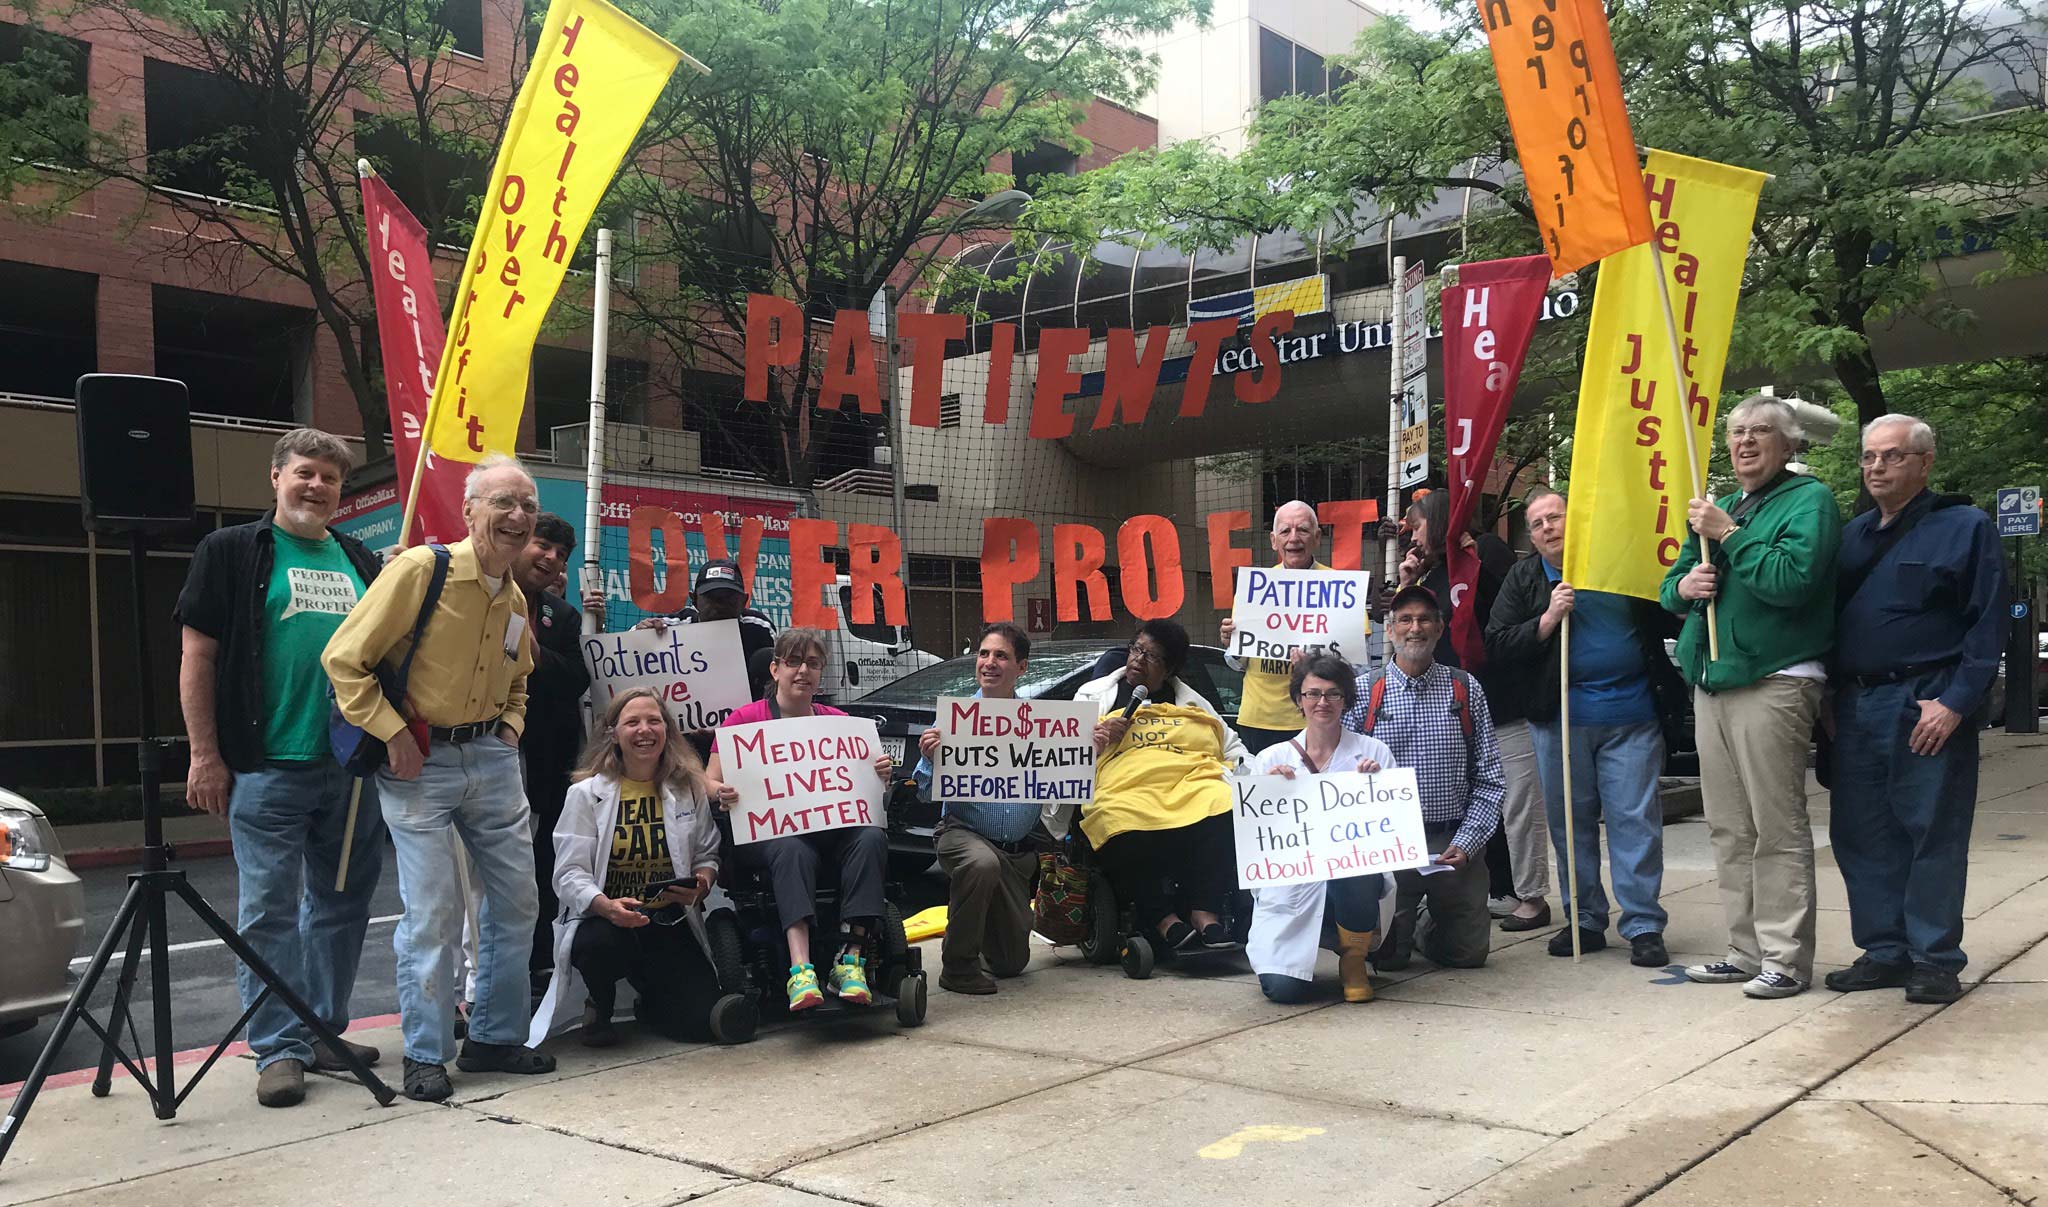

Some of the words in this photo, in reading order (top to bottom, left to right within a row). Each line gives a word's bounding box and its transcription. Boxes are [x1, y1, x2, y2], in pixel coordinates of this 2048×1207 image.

[499, 174, 527, 319] Over
[744, 292, 1295, 439] PATIENTS
[1402, 429, 1414, 445] PAY
[1415, 424, 1424, 440] TO
[1404, 440, 1422, 459] PARK
[355, 488, 396, 510] OfficeMax
[2003, 523, 2033, 533] HERE
[2007, 516, 2029, 525] PAY
[291, 569, 348, 584] PEOPLE
[627, 505, 909, 631] OVER
[979, 498, 1379, 623] PROFT
[294, 583, 353, 598] BEFORE
[1247, 570, 1357, 609] PATIENTS
[295, 597, 356, 613] PROFITS
[2014, 604, 2023, 616] P
[1266, 612, 1329, 634] OVER
[584, 629, 708, 681] Patients
[1136, 716, 1184, 726] OPLE
[732, 728, 870, 769] MEDICAID
[1132, 731, 1168, 742] NOT
[941, 745, 999, 768] PUTS
[1009, 741, 1093, 768] WEALTH
[763, 765, 854, 801] LIVES
[940, 774, 1020, 800] BEFORE
[1024, 769, 1092, 800] HEALTH
[1237, 781, 1309, 824] Keep
[1319, 774, 1413, 812] Doctors
[747, 798, 873, 841] MATTER
[1256, 821, 1314, 852] that
[1330, 816, 1395, 843] care
[610, 824, 672, 862] CAR
[1245, 849, 1316, 881] about
[1326, 836, 1419, 879] patients
